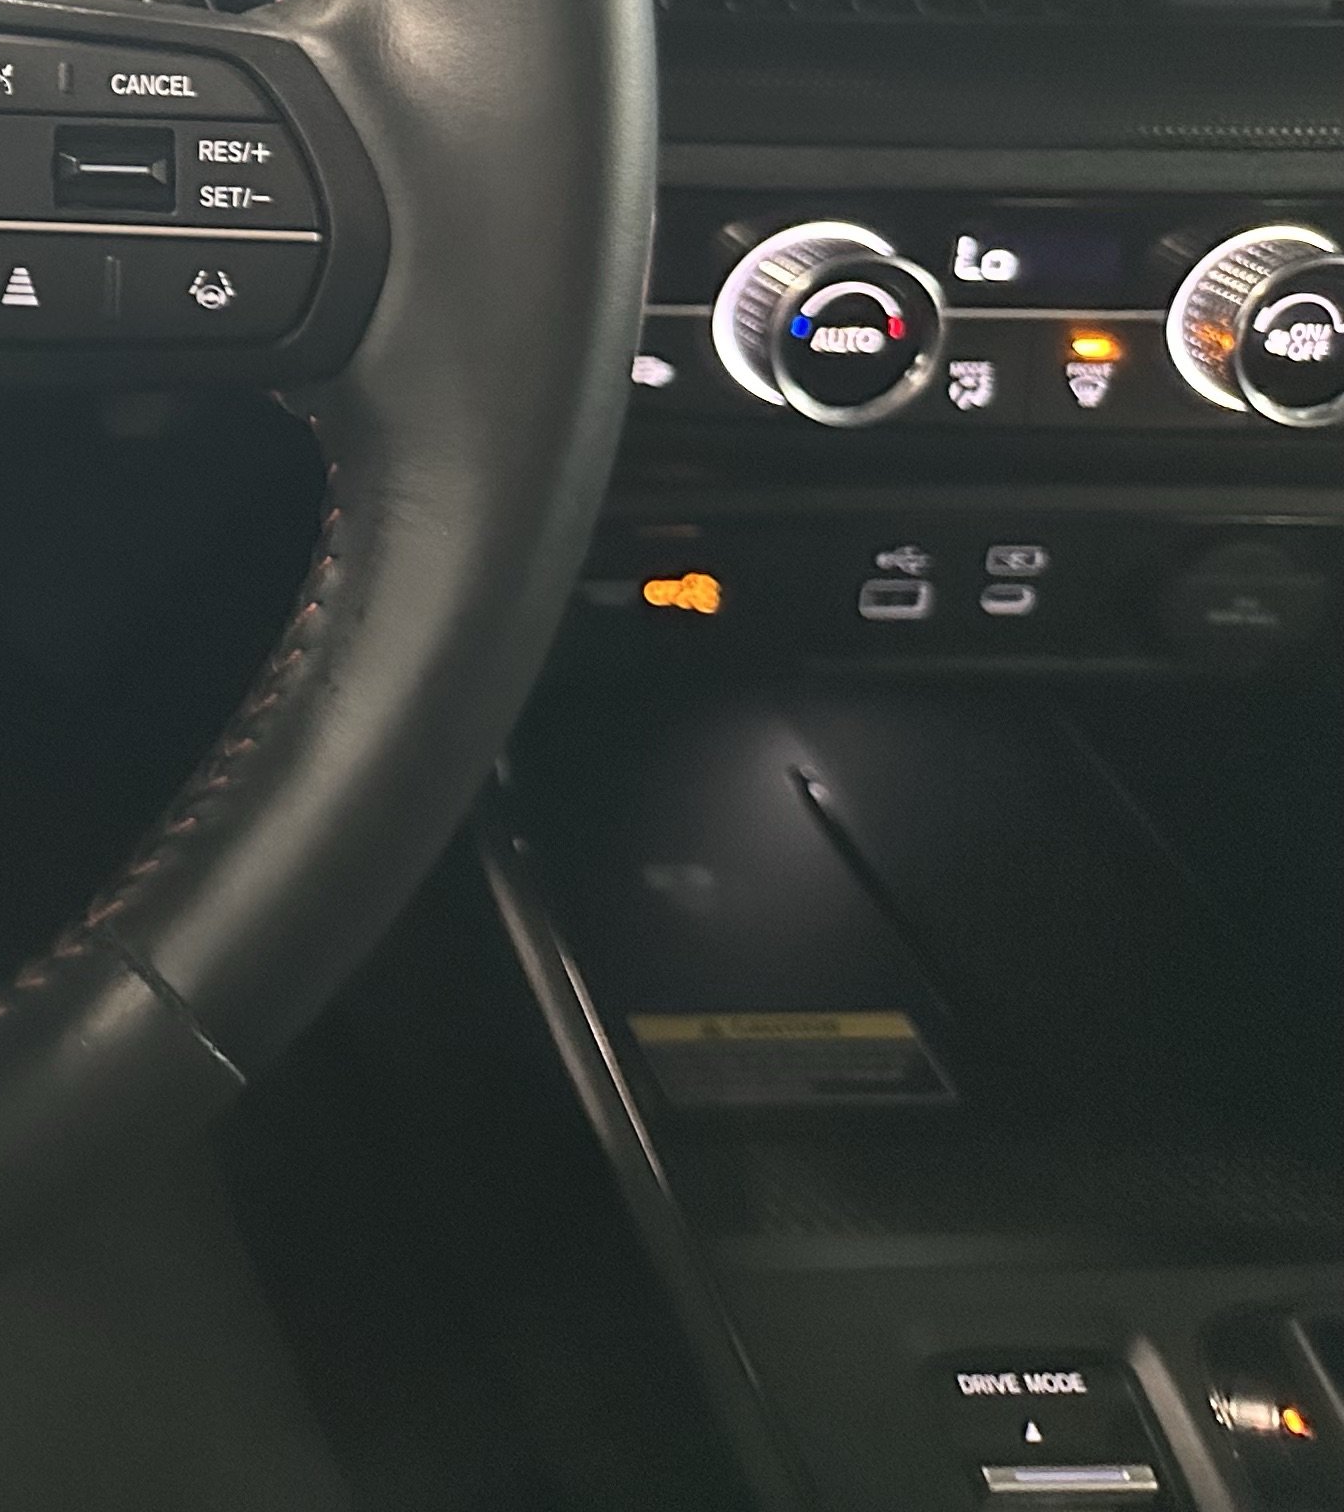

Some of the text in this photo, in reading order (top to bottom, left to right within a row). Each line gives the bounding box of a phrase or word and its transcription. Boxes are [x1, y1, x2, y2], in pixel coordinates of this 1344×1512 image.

[110, 74, 198, 98] CANCEL
[198, 140, 272, 164] RES/+
[954, 235, 1019, 282] Lo
[810, 326, 886, 354] AUTO
[957, 1372, 1087, 1395] DRIVE MODE
